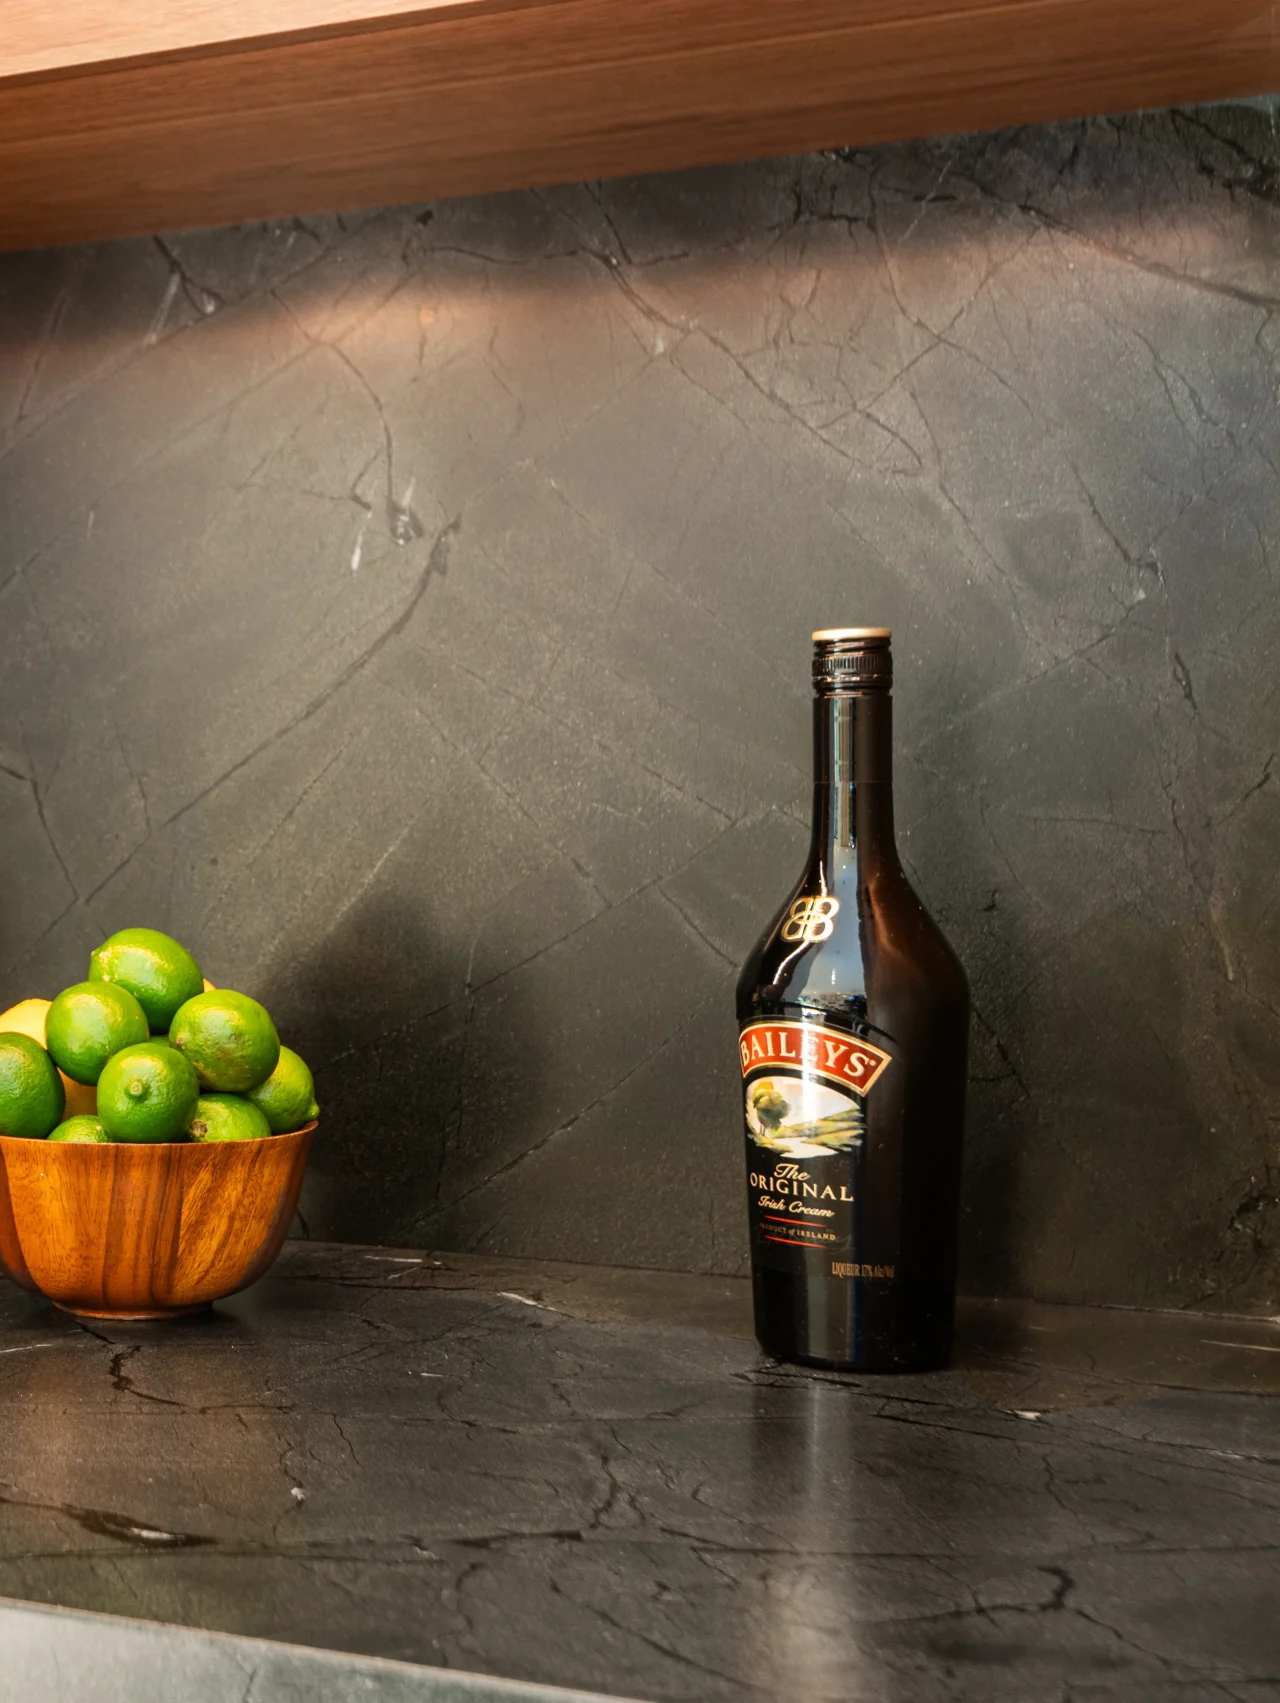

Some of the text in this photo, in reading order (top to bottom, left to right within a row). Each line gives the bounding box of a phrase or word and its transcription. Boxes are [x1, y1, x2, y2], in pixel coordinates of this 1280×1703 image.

[740, 1031, 870, 1078] BAILEYS
[773, 1163, 811, 1182] The
[749, 1172, 855, 1202] ORIGINAL
[757, 1195, 836, 1218] Irish Cream
[796, 1229, 837, 1241] IRELAND
[831, 1262, 861, 1279] LIQUEUR
